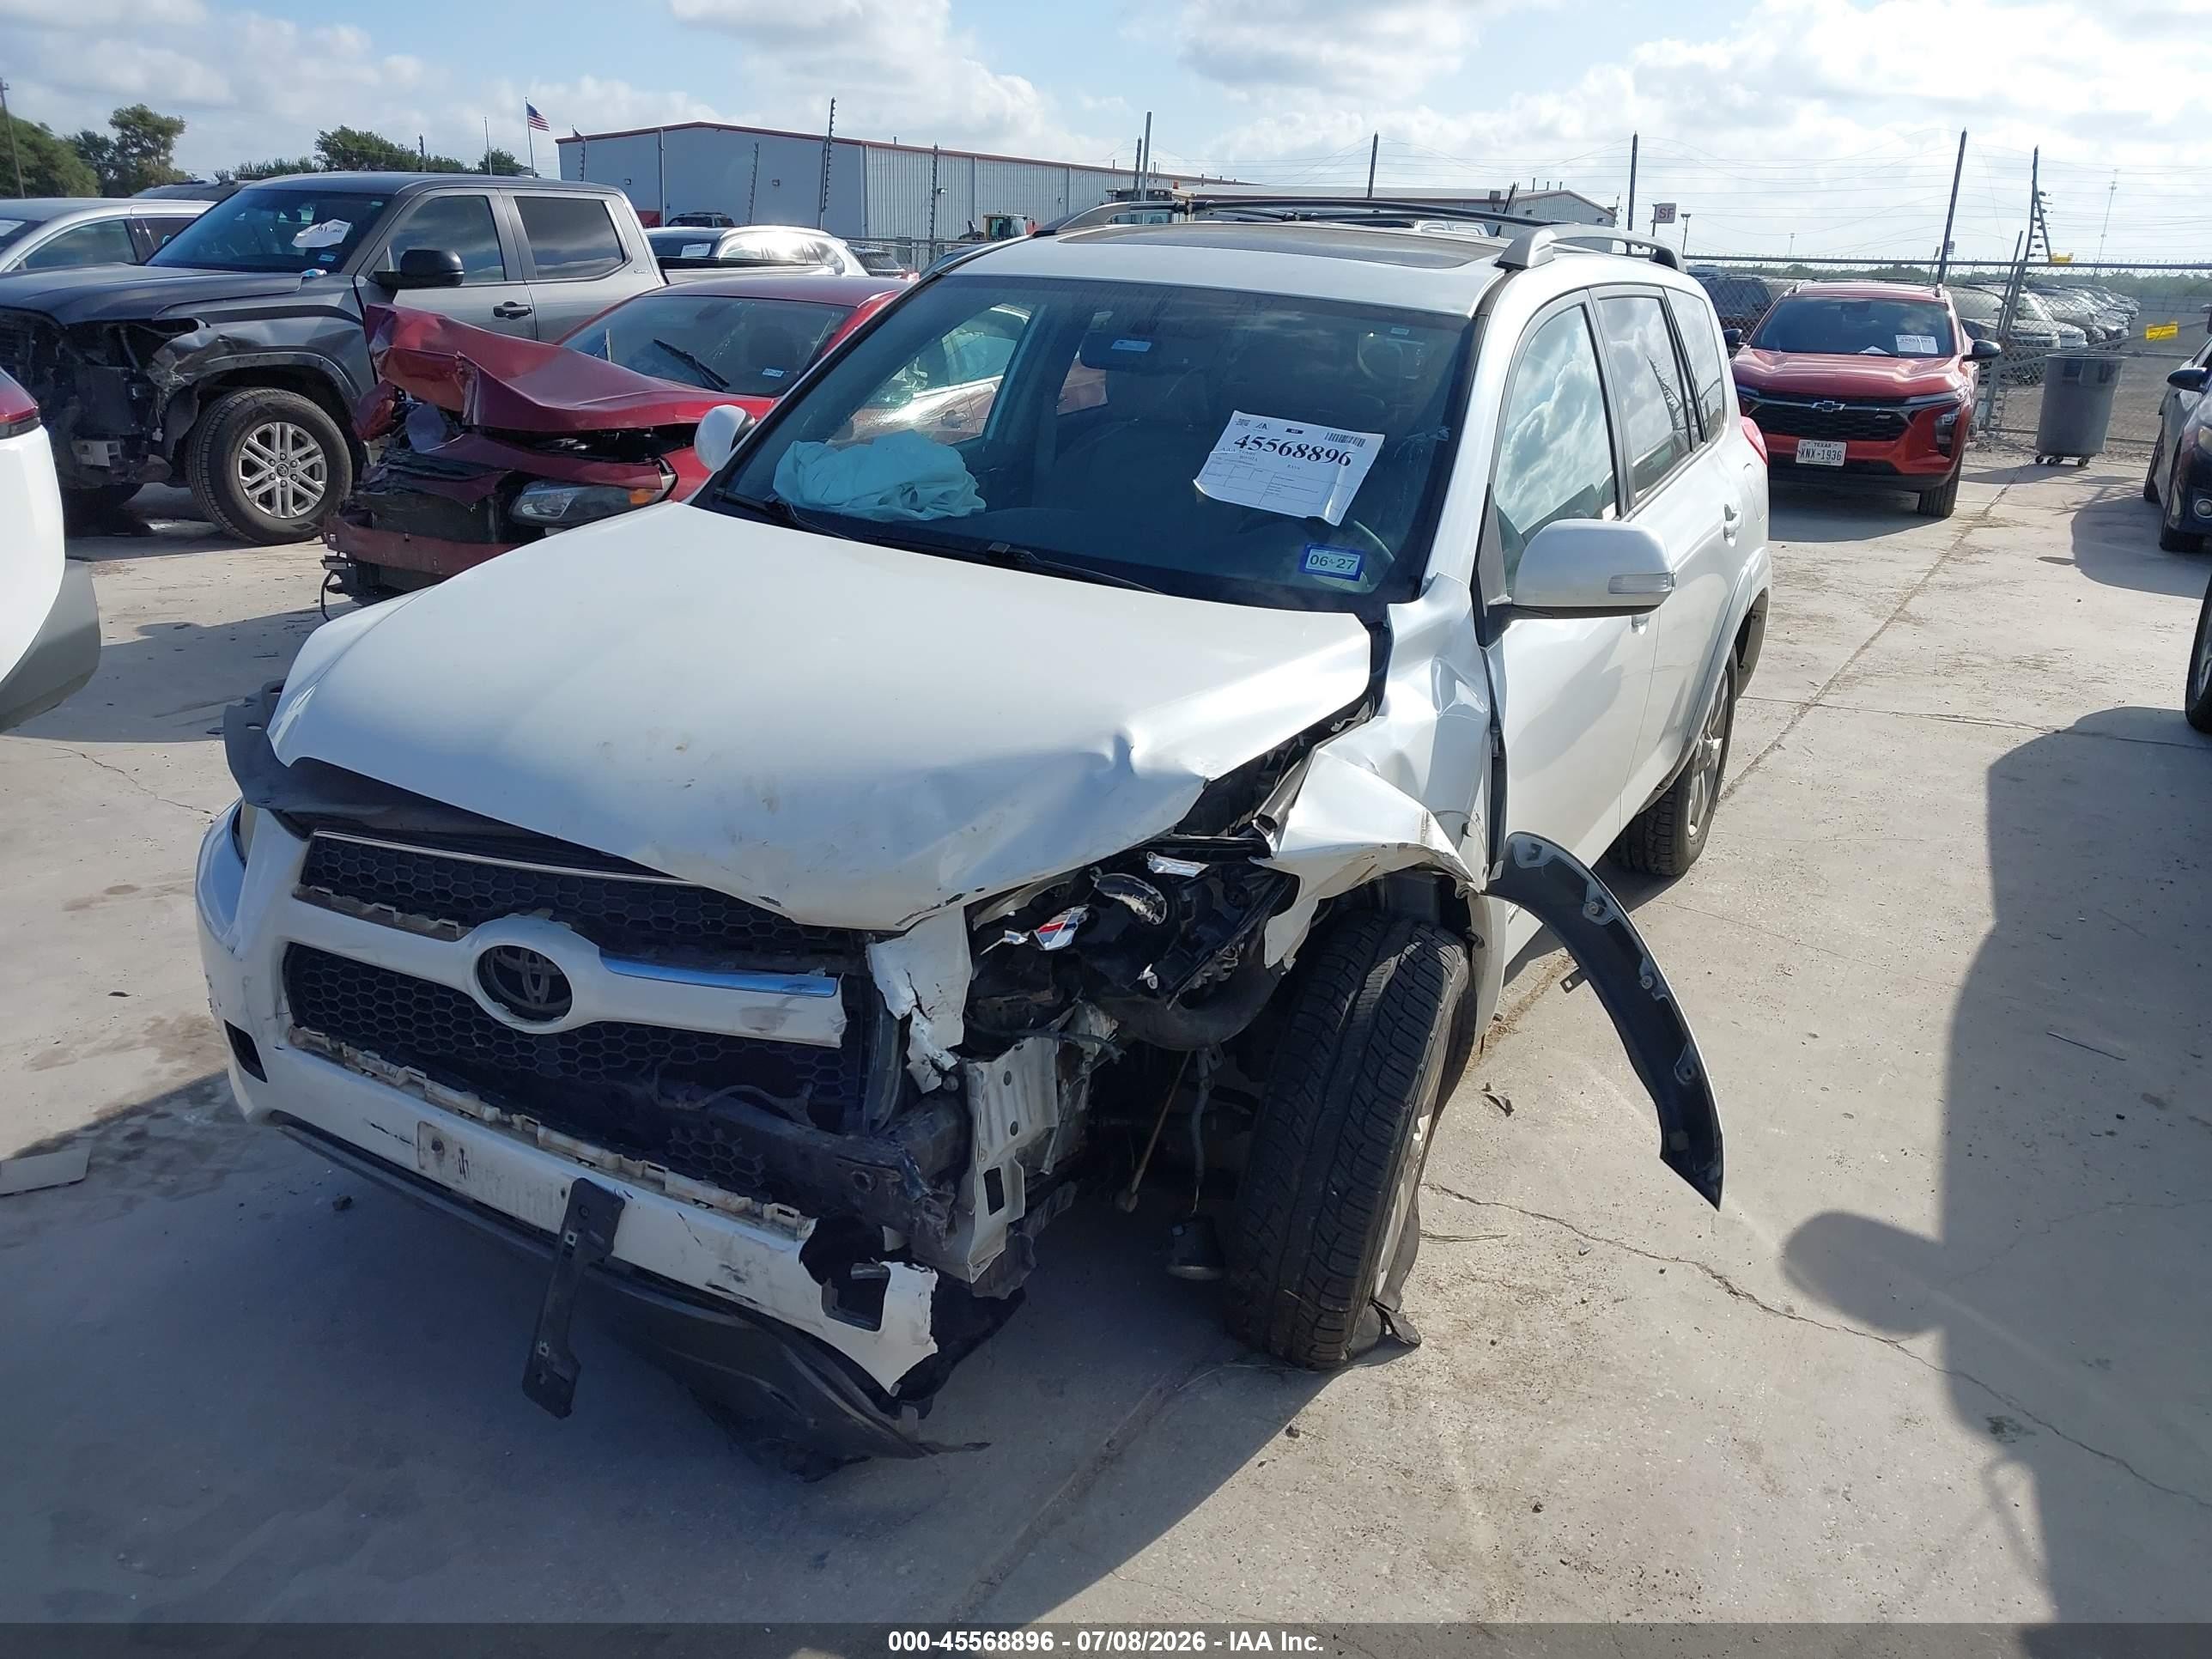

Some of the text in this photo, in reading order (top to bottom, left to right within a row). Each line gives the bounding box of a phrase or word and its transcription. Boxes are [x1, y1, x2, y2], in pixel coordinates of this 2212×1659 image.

[1659, 208, 1674, 219] SF
[1233, 434, 1356, 467] 45568896
[1310, 555, 1328, 567] 06
[1336, 558, 1357, 570] 27
